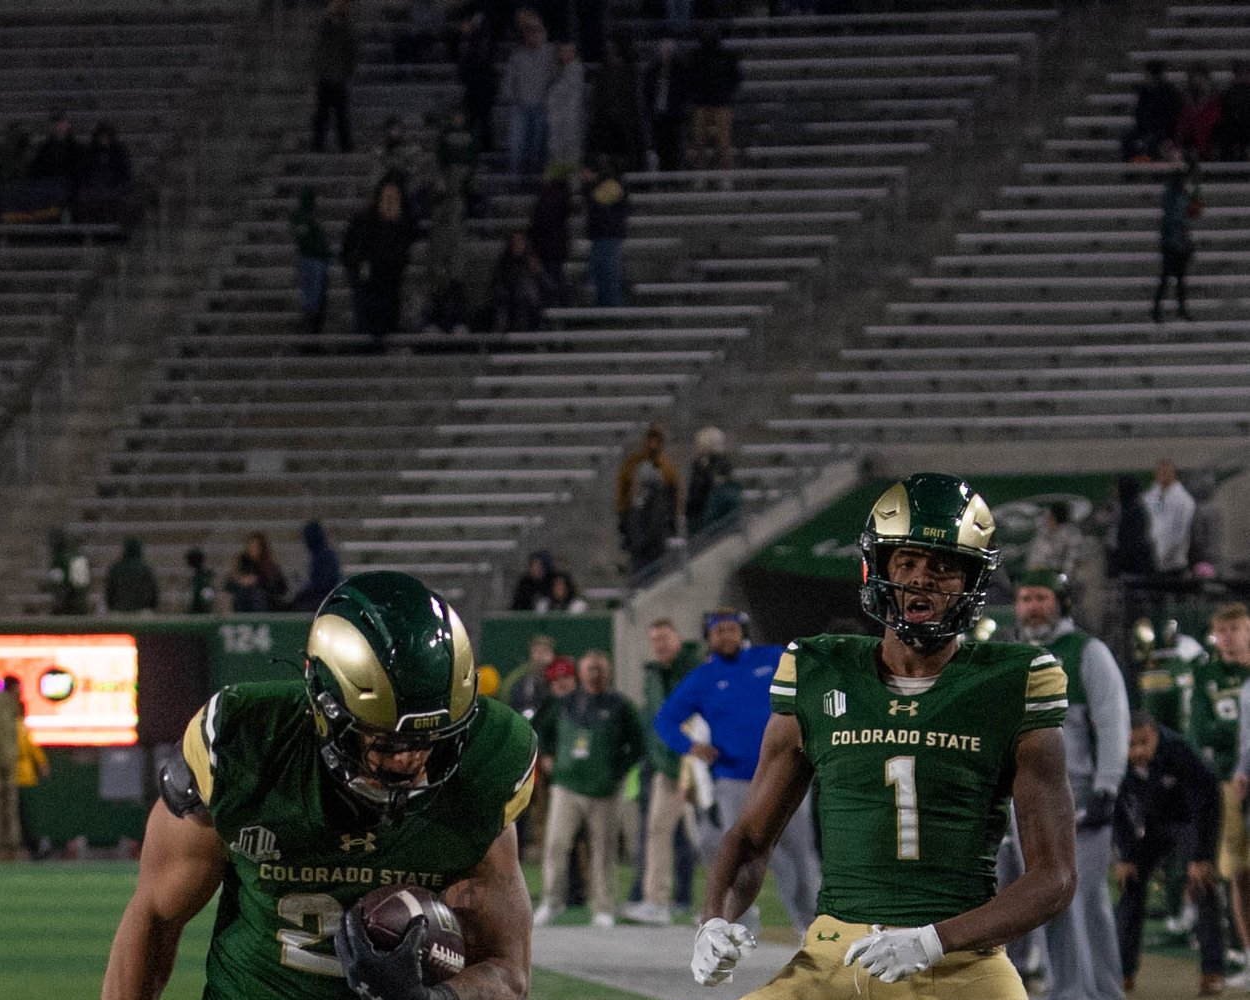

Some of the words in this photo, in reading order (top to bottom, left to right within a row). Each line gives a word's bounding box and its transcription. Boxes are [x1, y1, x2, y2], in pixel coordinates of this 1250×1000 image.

[922, 526, 948, 539] GRIT
[413, 716, 441, 729] GRIT
[831, 729, 920, 746] COLORADO
[925, 731, 981, 752] STATE
[885, 755, 920, 860] 1
[259, 863, 373, 885] COLORADO
[379, 869, 445, 887] STATE
